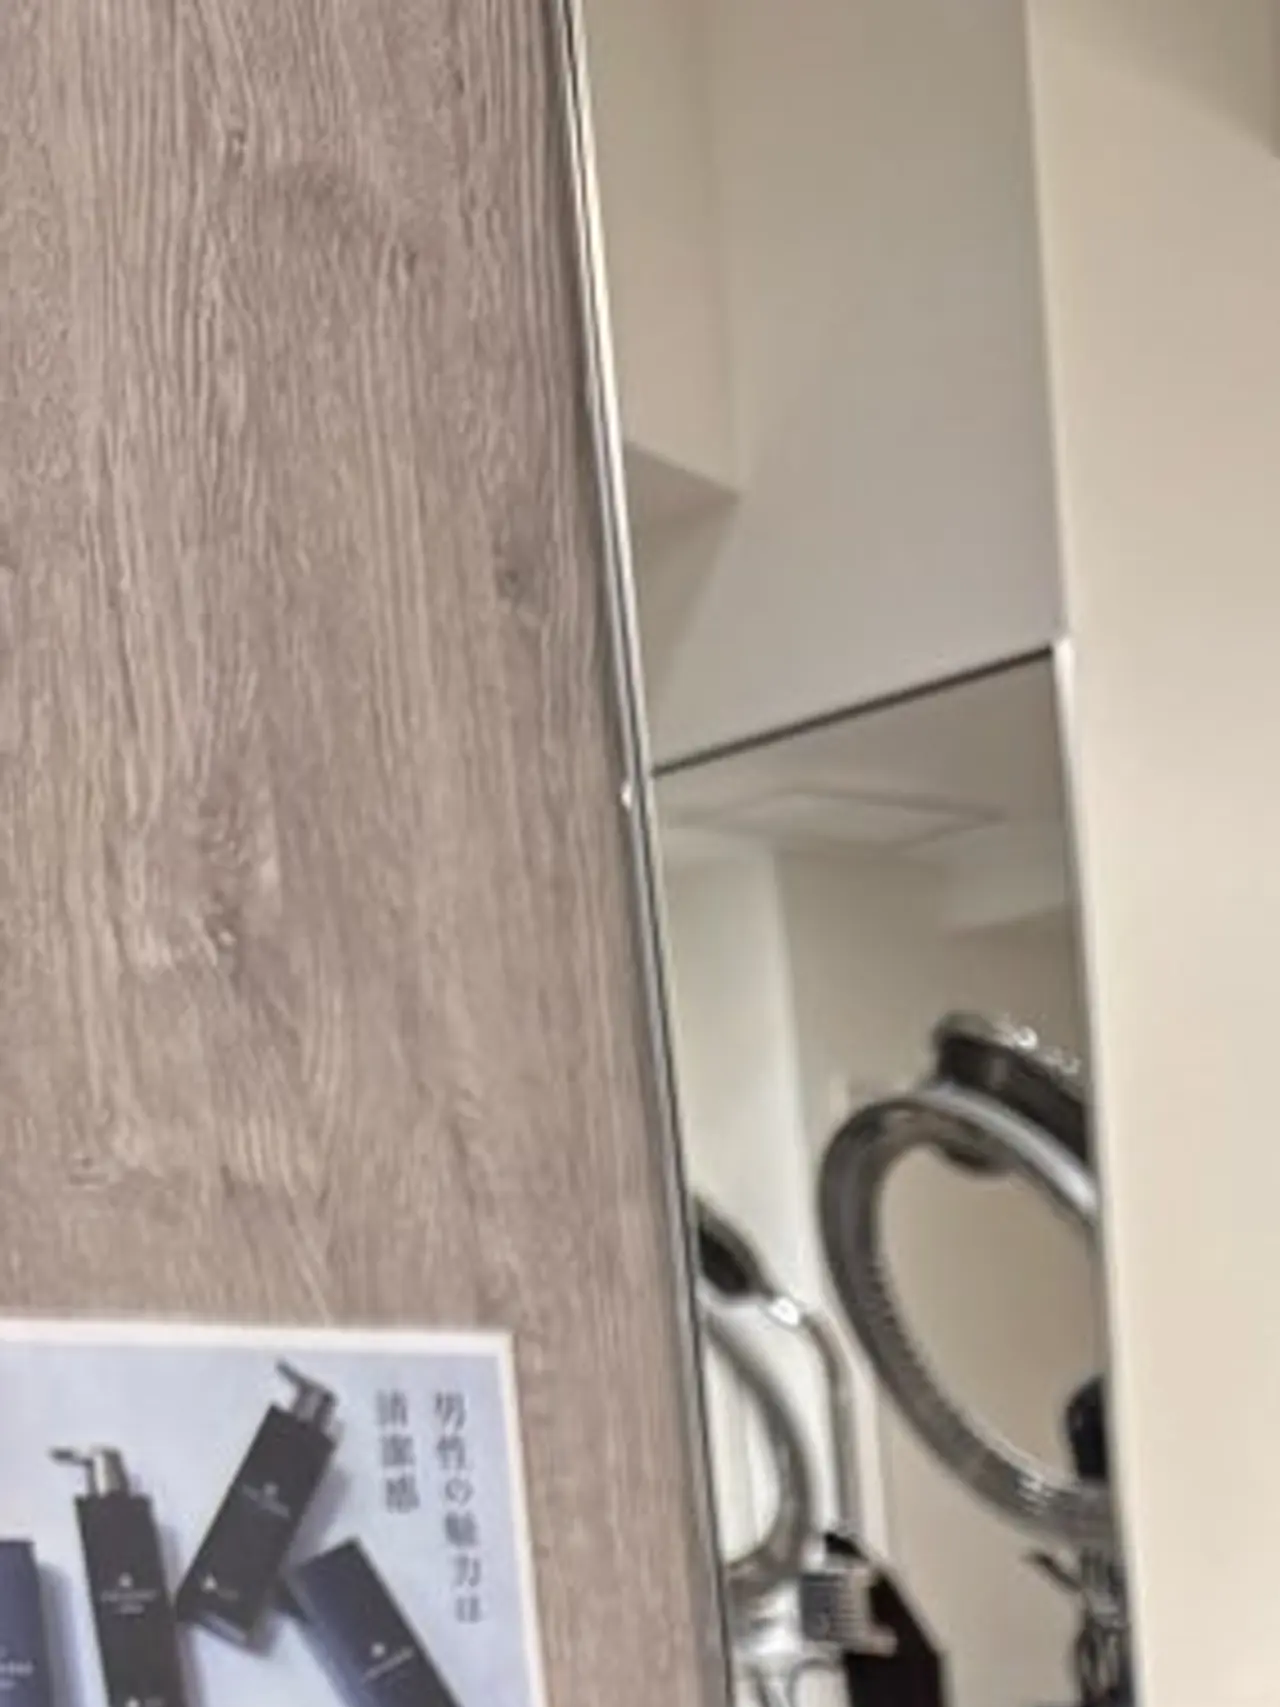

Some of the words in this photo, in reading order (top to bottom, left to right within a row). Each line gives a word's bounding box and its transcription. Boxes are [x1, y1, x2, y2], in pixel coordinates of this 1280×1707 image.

[434, 1391, 482, 1624] 男性の魅力は
